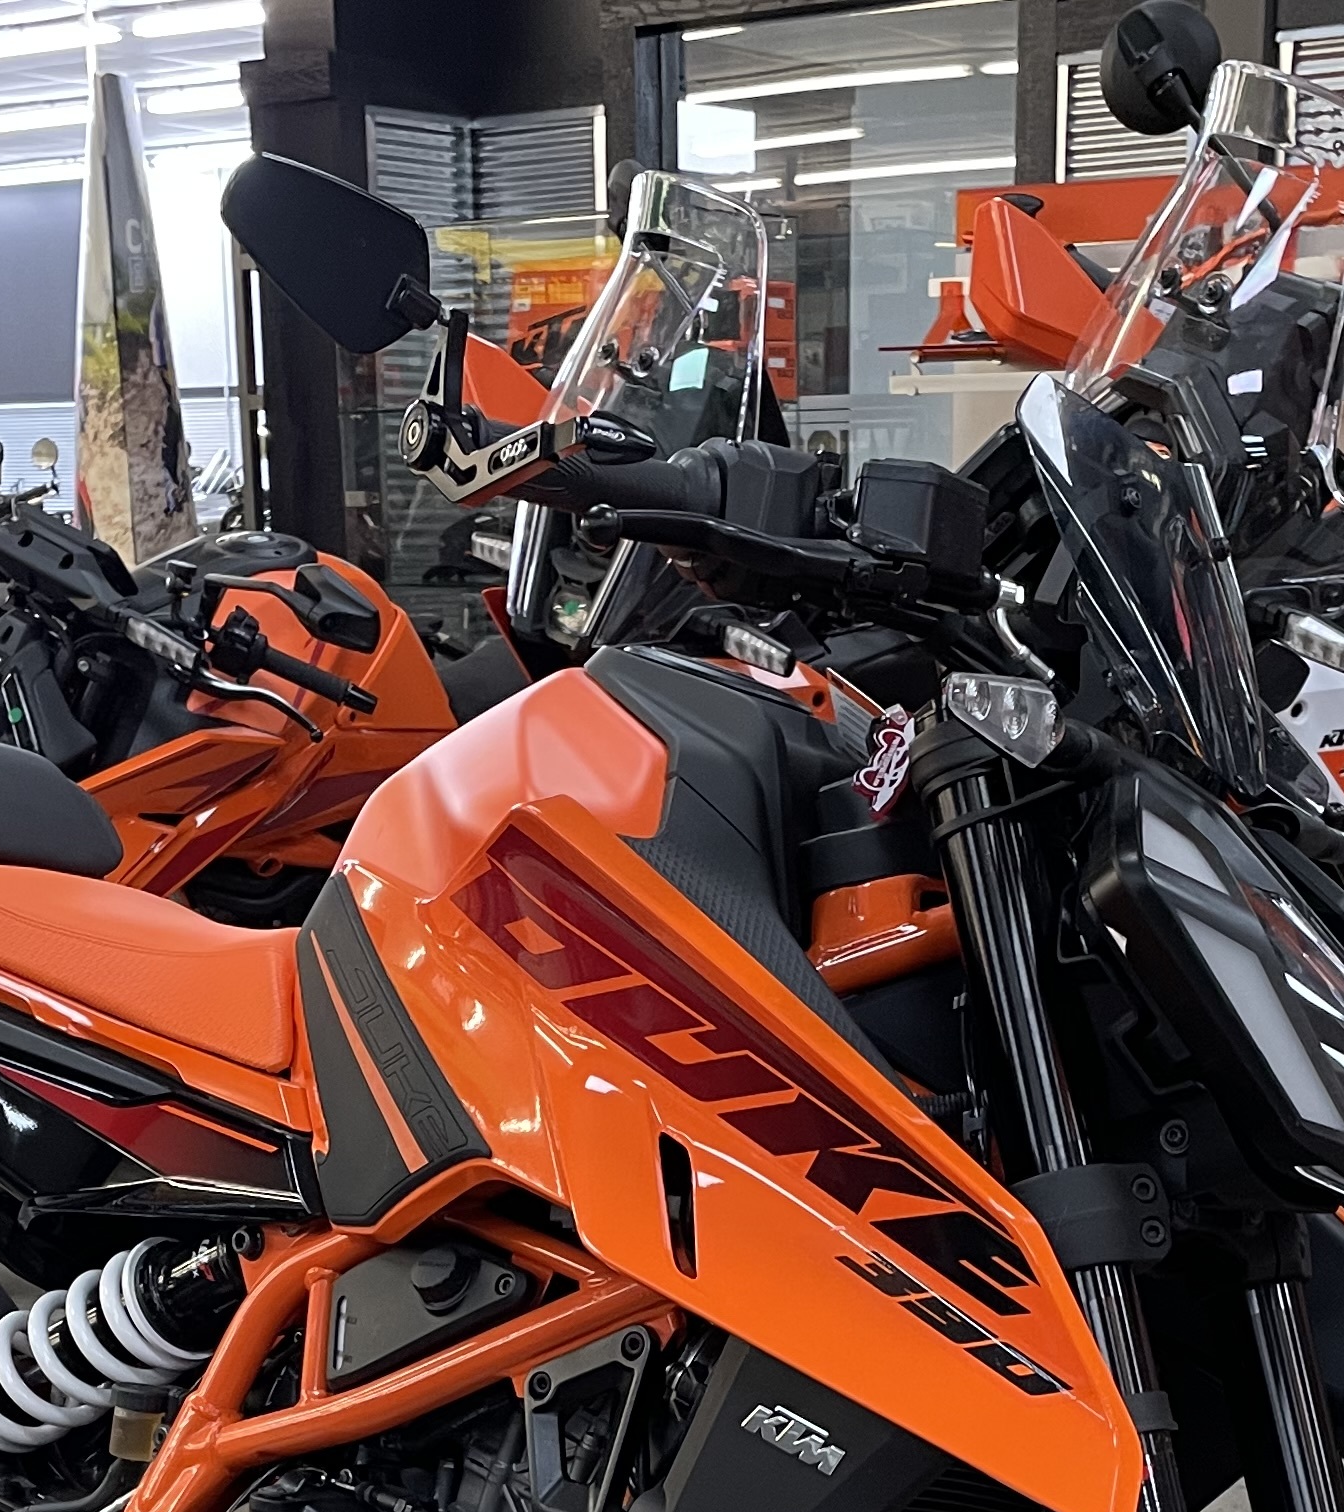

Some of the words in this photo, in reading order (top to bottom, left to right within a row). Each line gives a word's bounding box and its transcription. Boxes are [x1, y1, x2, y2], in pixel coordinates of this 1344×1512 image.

[450, 845, 1042, 1318] DUKE
[834, 1250, 1074, 1397] 390
[740, 1404, 846, 1476] KTM
